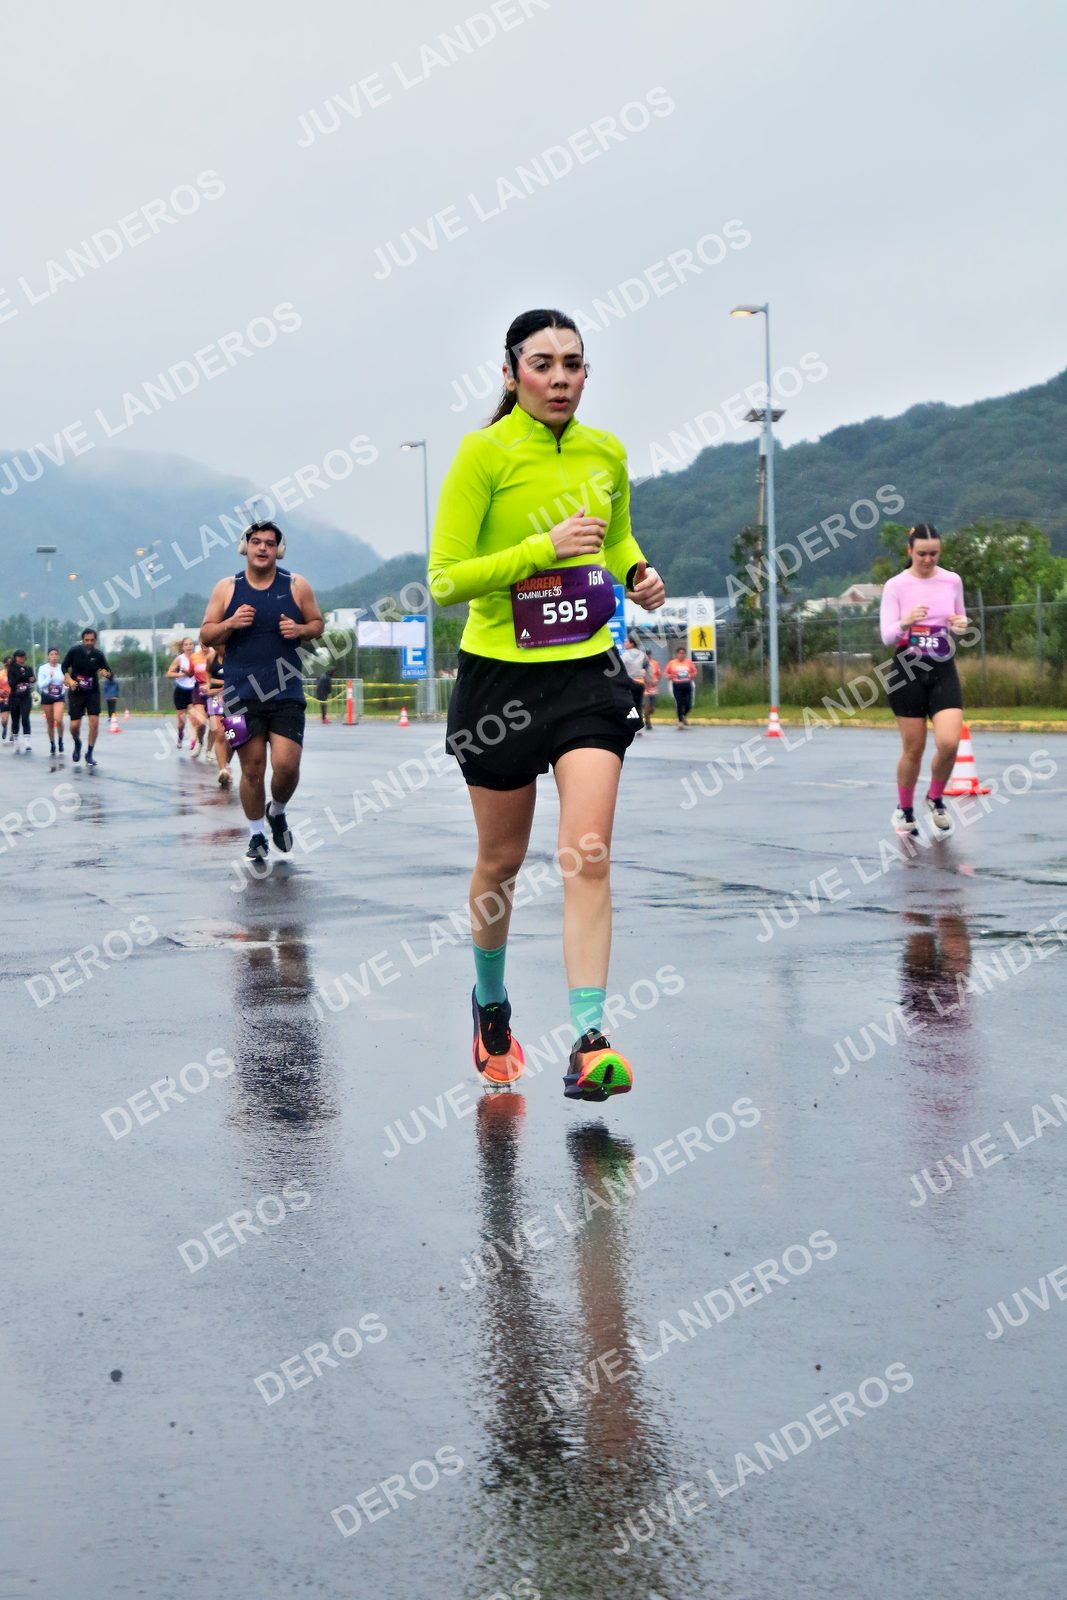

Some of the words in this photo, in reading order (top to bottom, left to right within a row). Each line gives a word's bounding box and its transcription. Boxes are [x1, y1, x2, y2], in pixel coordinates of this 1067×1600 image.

[516, 575, 562, 592] CARRERA
[542, 599, 588, 625] 595
[919, 636, 939, 648] 325
